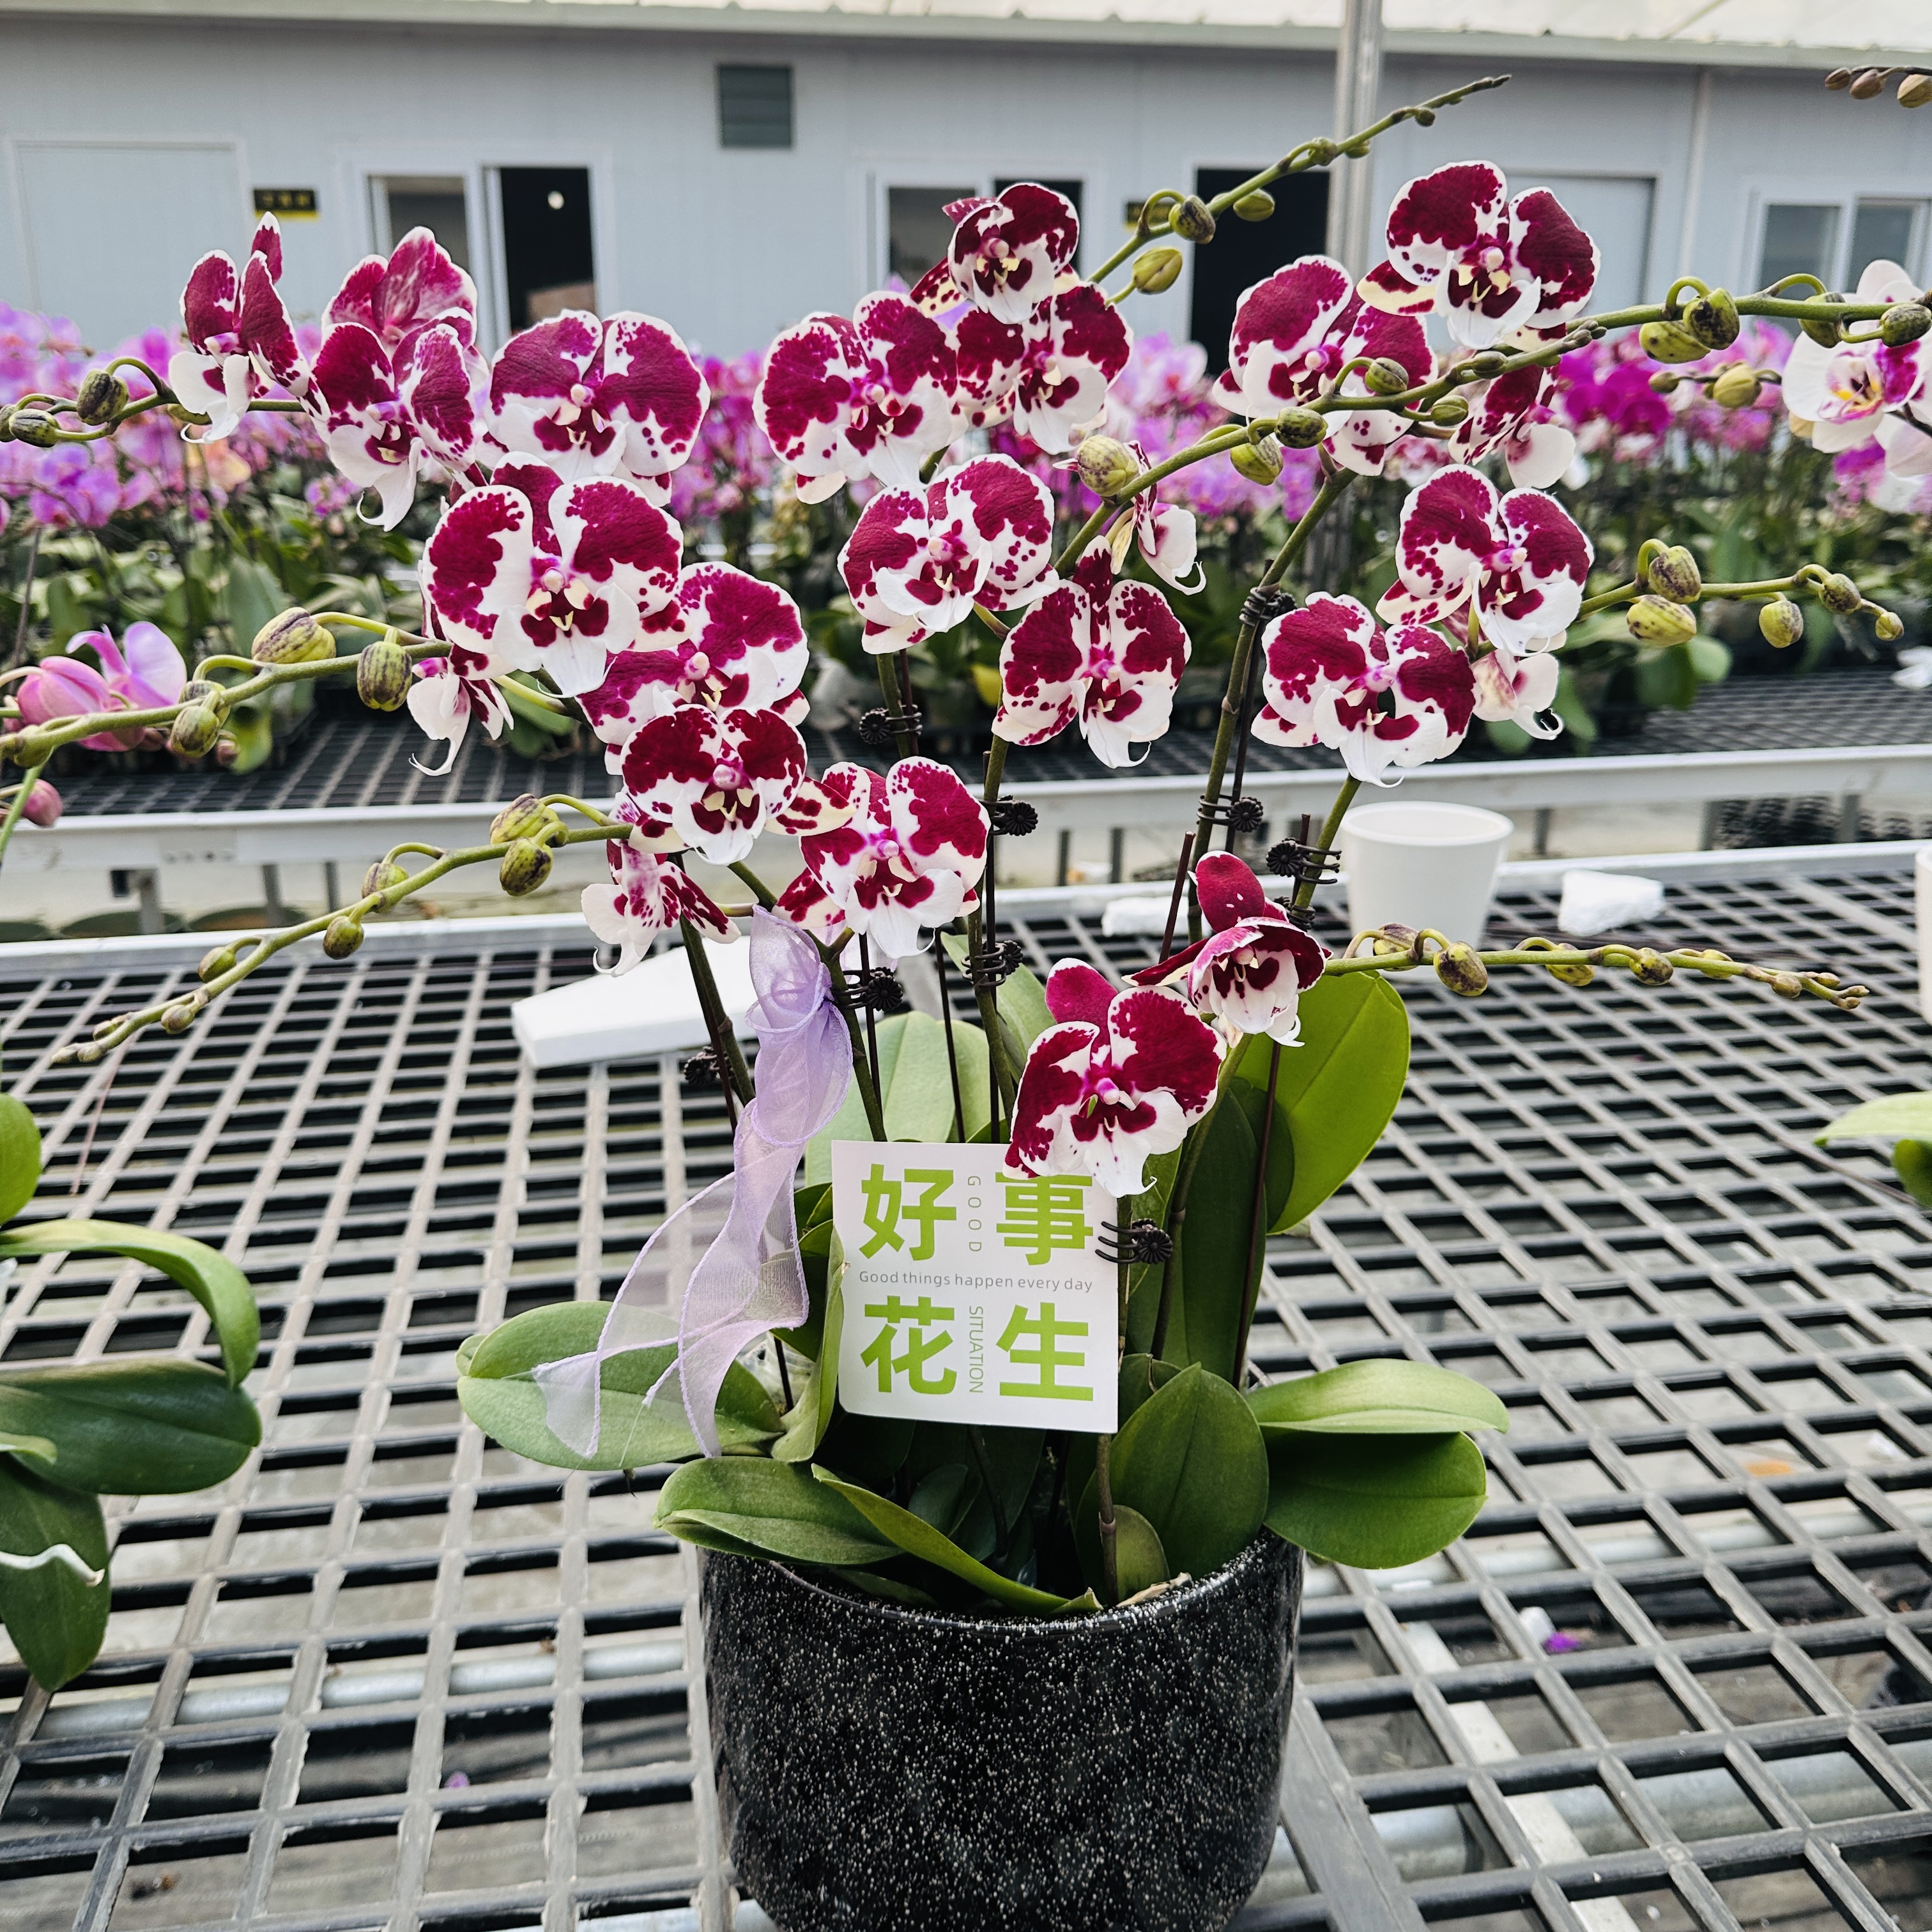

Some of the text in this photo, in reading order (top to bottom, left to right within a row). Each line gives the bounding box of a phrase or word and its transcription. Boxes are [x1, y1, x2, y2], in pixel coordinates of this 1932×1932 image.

[967, 1175, 983, 1252] GOOD
[859, 1270, 1093, 1294] Good things happen every day
[969, 1305, 984, 1394] SITUATION
